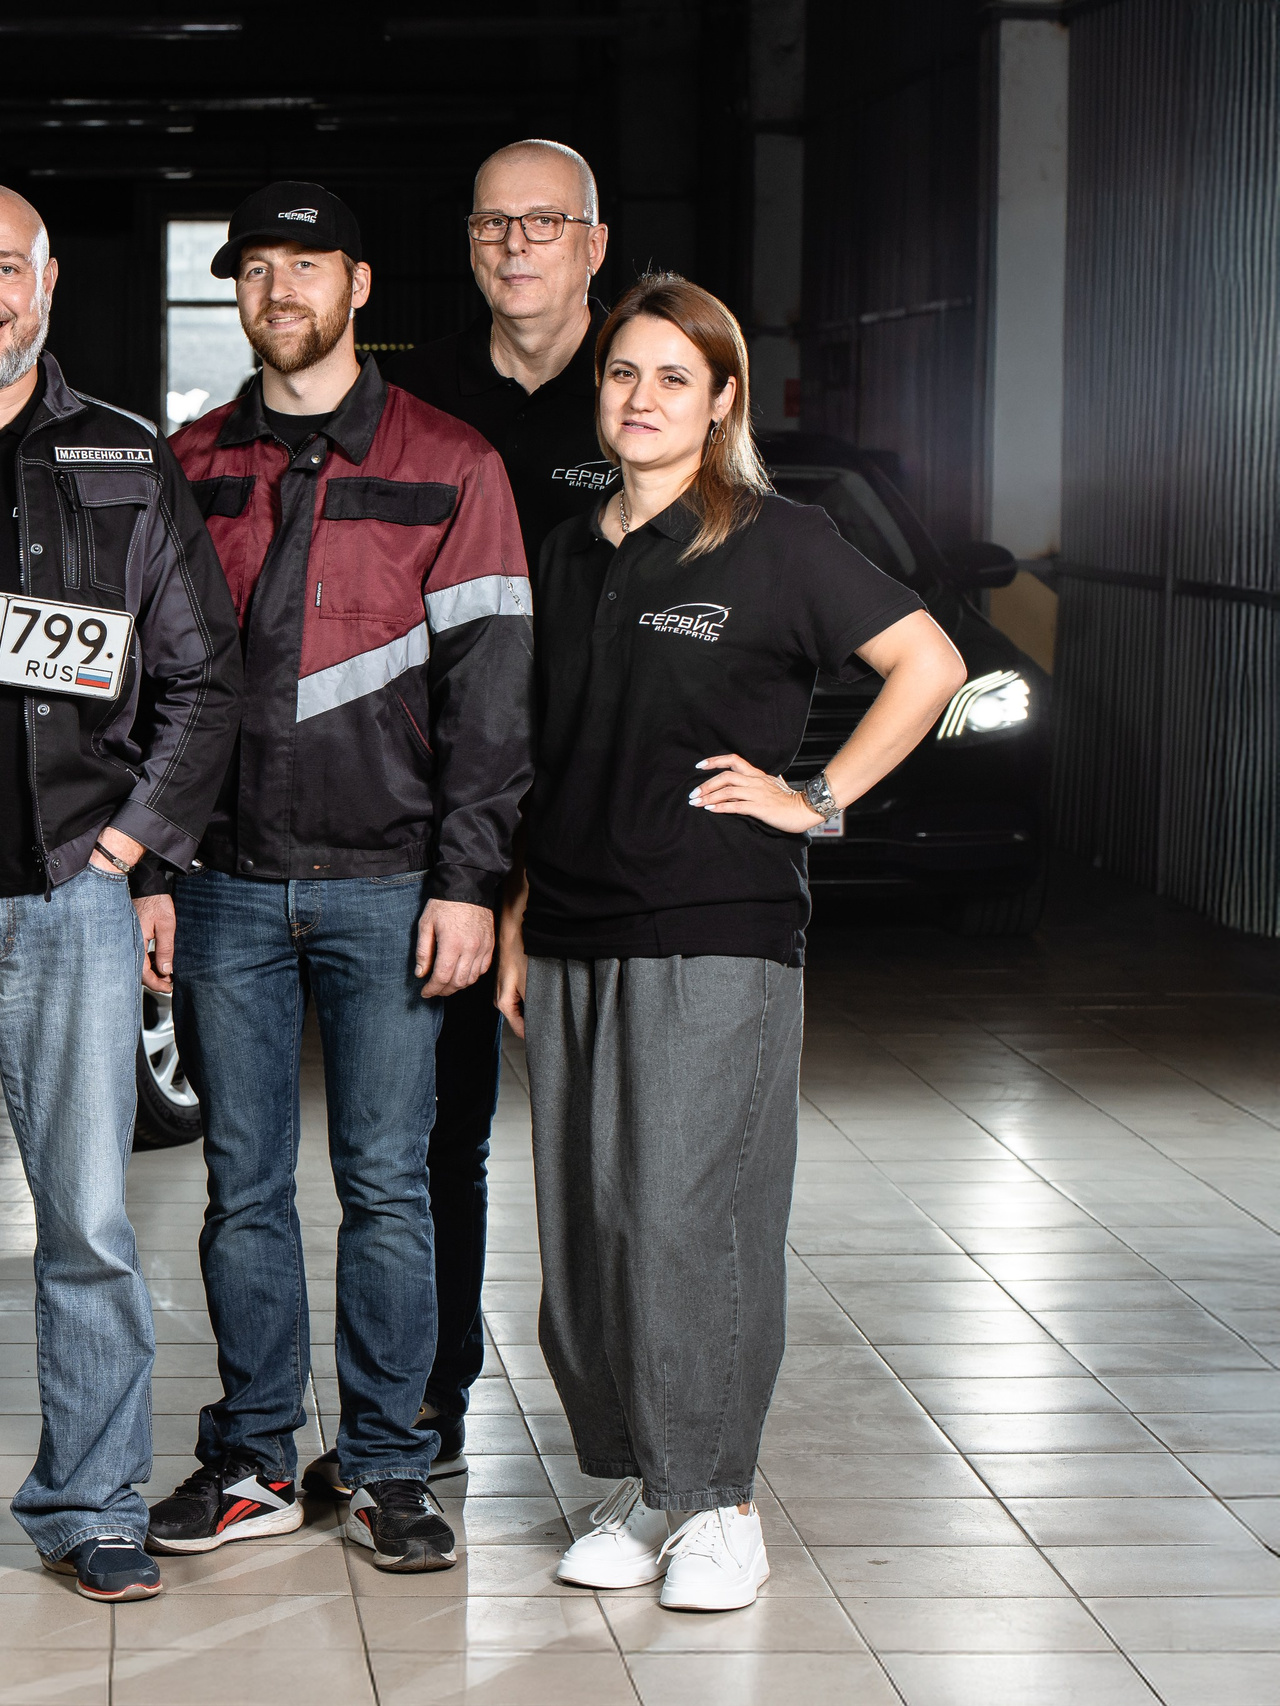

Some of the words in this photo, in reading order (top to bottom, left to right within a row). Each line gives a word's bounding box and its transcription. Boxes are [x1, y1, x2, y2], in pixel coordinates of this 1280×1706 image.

[60, 450, 123, 460] МАТВЕЕНКО
[126, 451, 149, 461] П.А.
[9, 606, 108, 665] 799
[638, 612, 725, 637] СЕРВИС
[654, 624, 719, 643] ИНТЕГРАТОР
[25, 659, 74, 683] RUS
